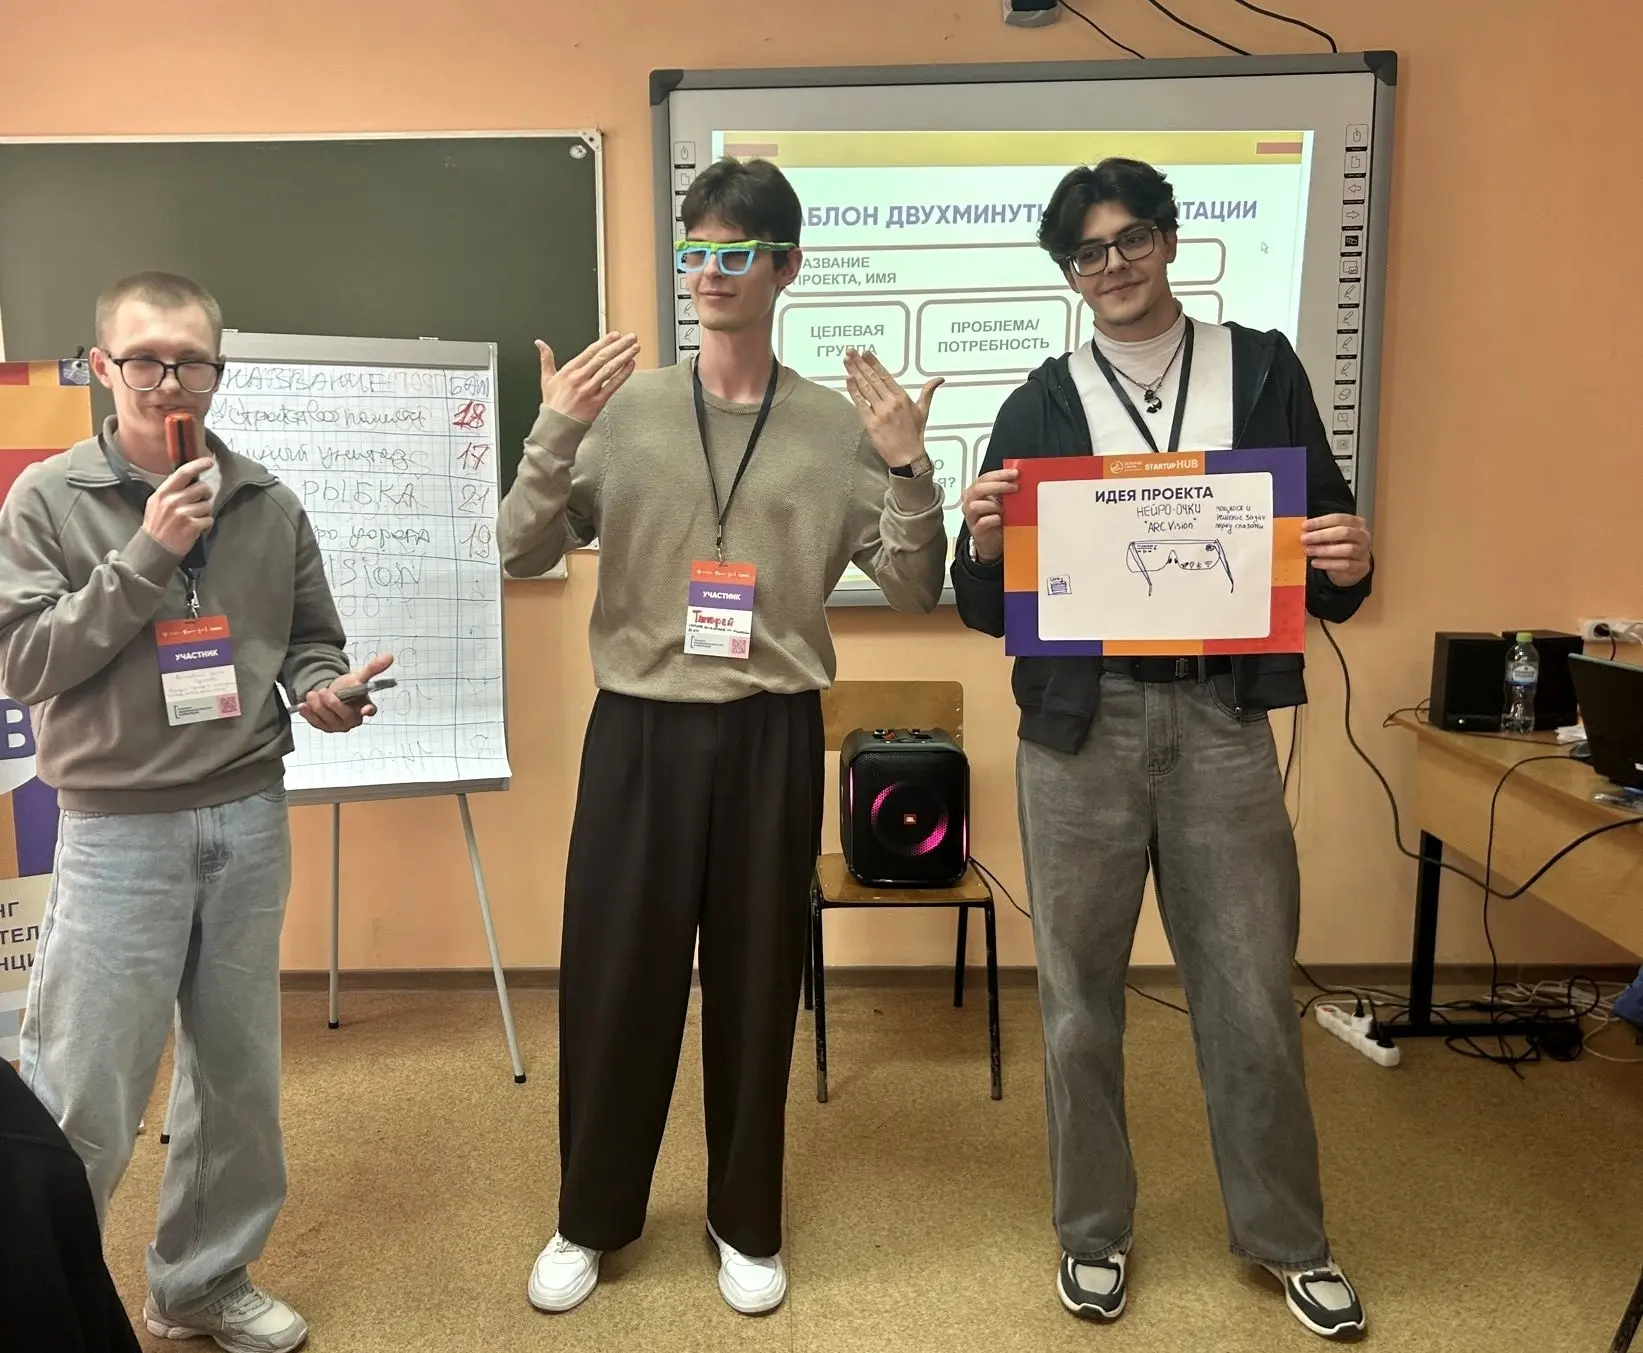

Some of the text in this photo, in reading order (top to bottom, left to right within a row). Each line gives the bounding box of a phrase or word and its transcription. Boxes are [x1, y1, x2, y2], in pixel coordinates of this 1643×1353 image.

[803, 256, 870, 269] АЗВАНИЕ
[866, 272, 896, 284] ИМЯ
[810, 324, 884, 339] ЦЕЛЕВАЯ
[951, 318, 1040, 333] ПРОБЛЕМА/
[938, 337, 1050, 353] ПОТРЕБНОСТЬ
[453, 400, 486, 430] 18
[457, 442, 490, 470] 17
[303, 479, 490, 513] РЫБКА 21
[1095, 486, 1213, 504] ИДЕЯ ПРОЕКТА
[1136, 503, 1201, 518] НЕЙРО-ОЧКИ
[322, 553, 427, 589] ISION
[703, 590, 741, 601] УЧАСТНИК
[175, 649, 219, 661] УЧАСТНИК
